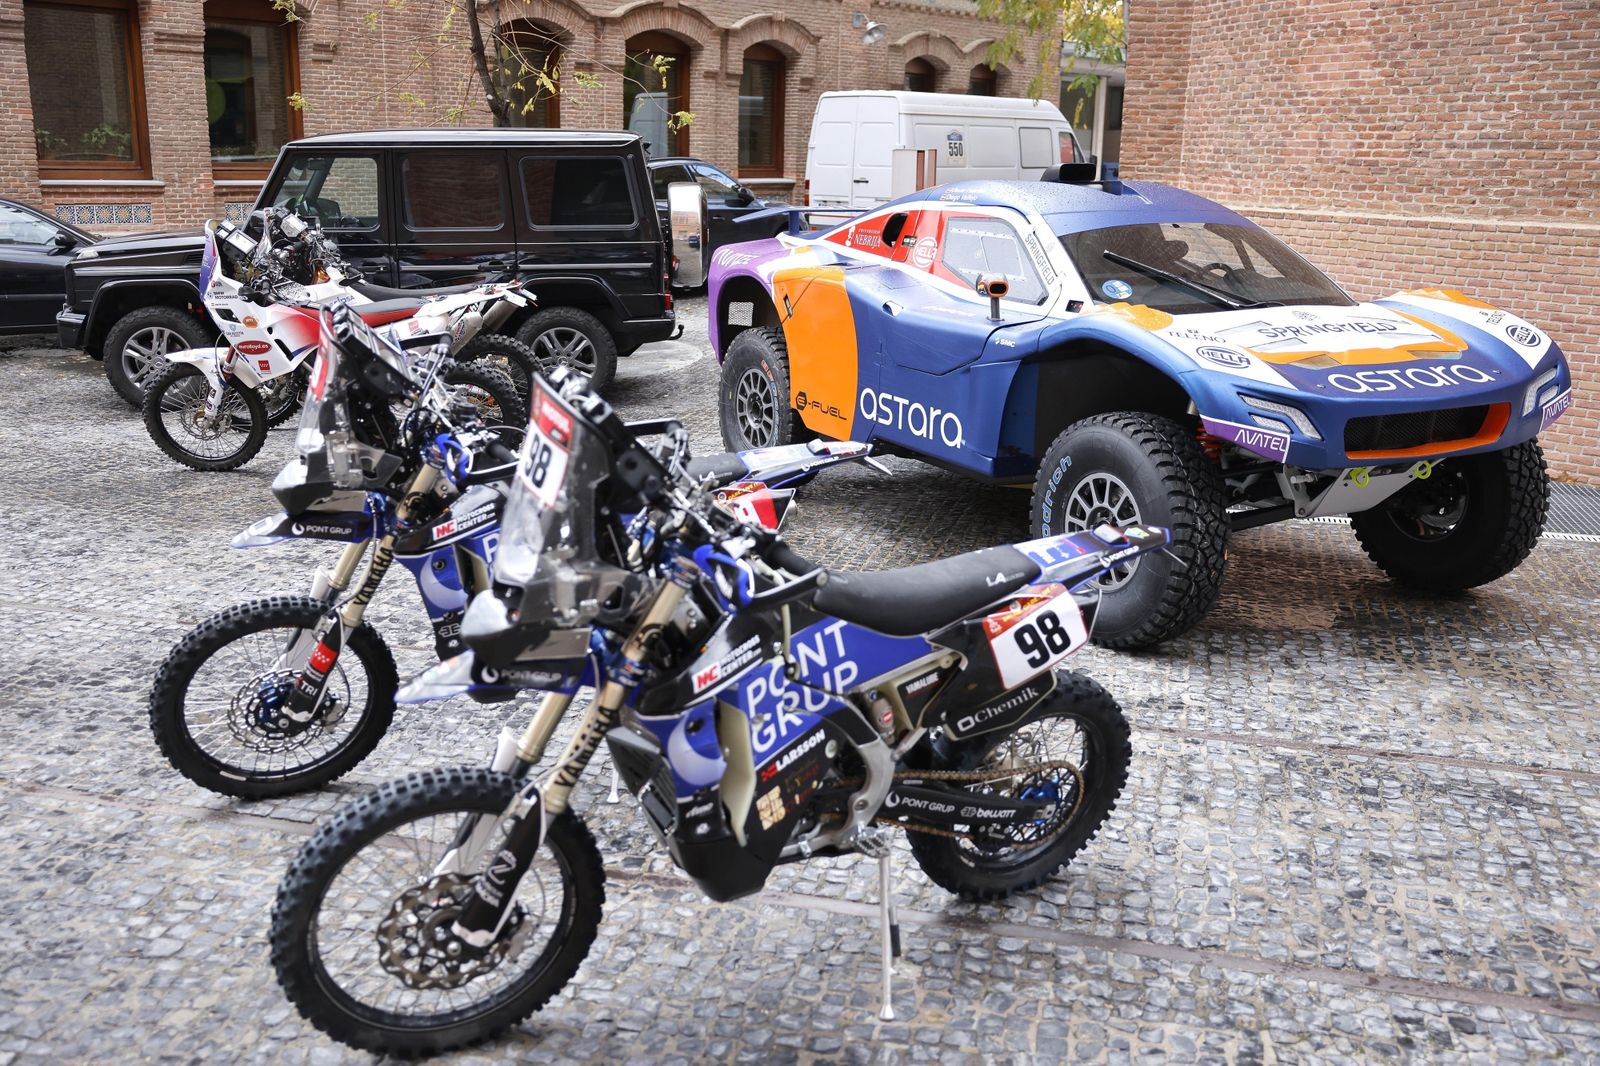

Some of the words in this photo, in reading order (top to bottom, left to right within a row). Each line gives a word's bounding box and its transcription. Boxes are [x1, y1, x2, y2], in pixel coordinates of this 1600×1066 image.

[948, 142, 964, 157] 550
[1024, 233, 1056, 286] SPRINGFIELD
[1258, 321, 1398, 338] SPRINGFIELD
[1199, 349, 1251, 366] HELLA
[1327, 364, 1496, 394] astara
[859, 387, 963, 448] astara
[1234, 429, 1288, 453] AVATEL
[524, 432, 552, 489] 98
[306, 525, 329, 534] PONT
[329, 526, 352, 535] GRUP
[353, 546, 394, 606] YAMAHA
[985, 572, 1007, 587] LA
[1013, 609, 1072, 669] 98
[300, 680, 319, 696] TRI
[746, 619, 848, 722] PONT
[750, 660, 859, 757] GRUP
[973, 687, 1040, 728] Chemik
[775, 729, 826, 773] LARSSON
[902, 797, 928, 809] PONT
[928, 802, 956, 814] GRUP
